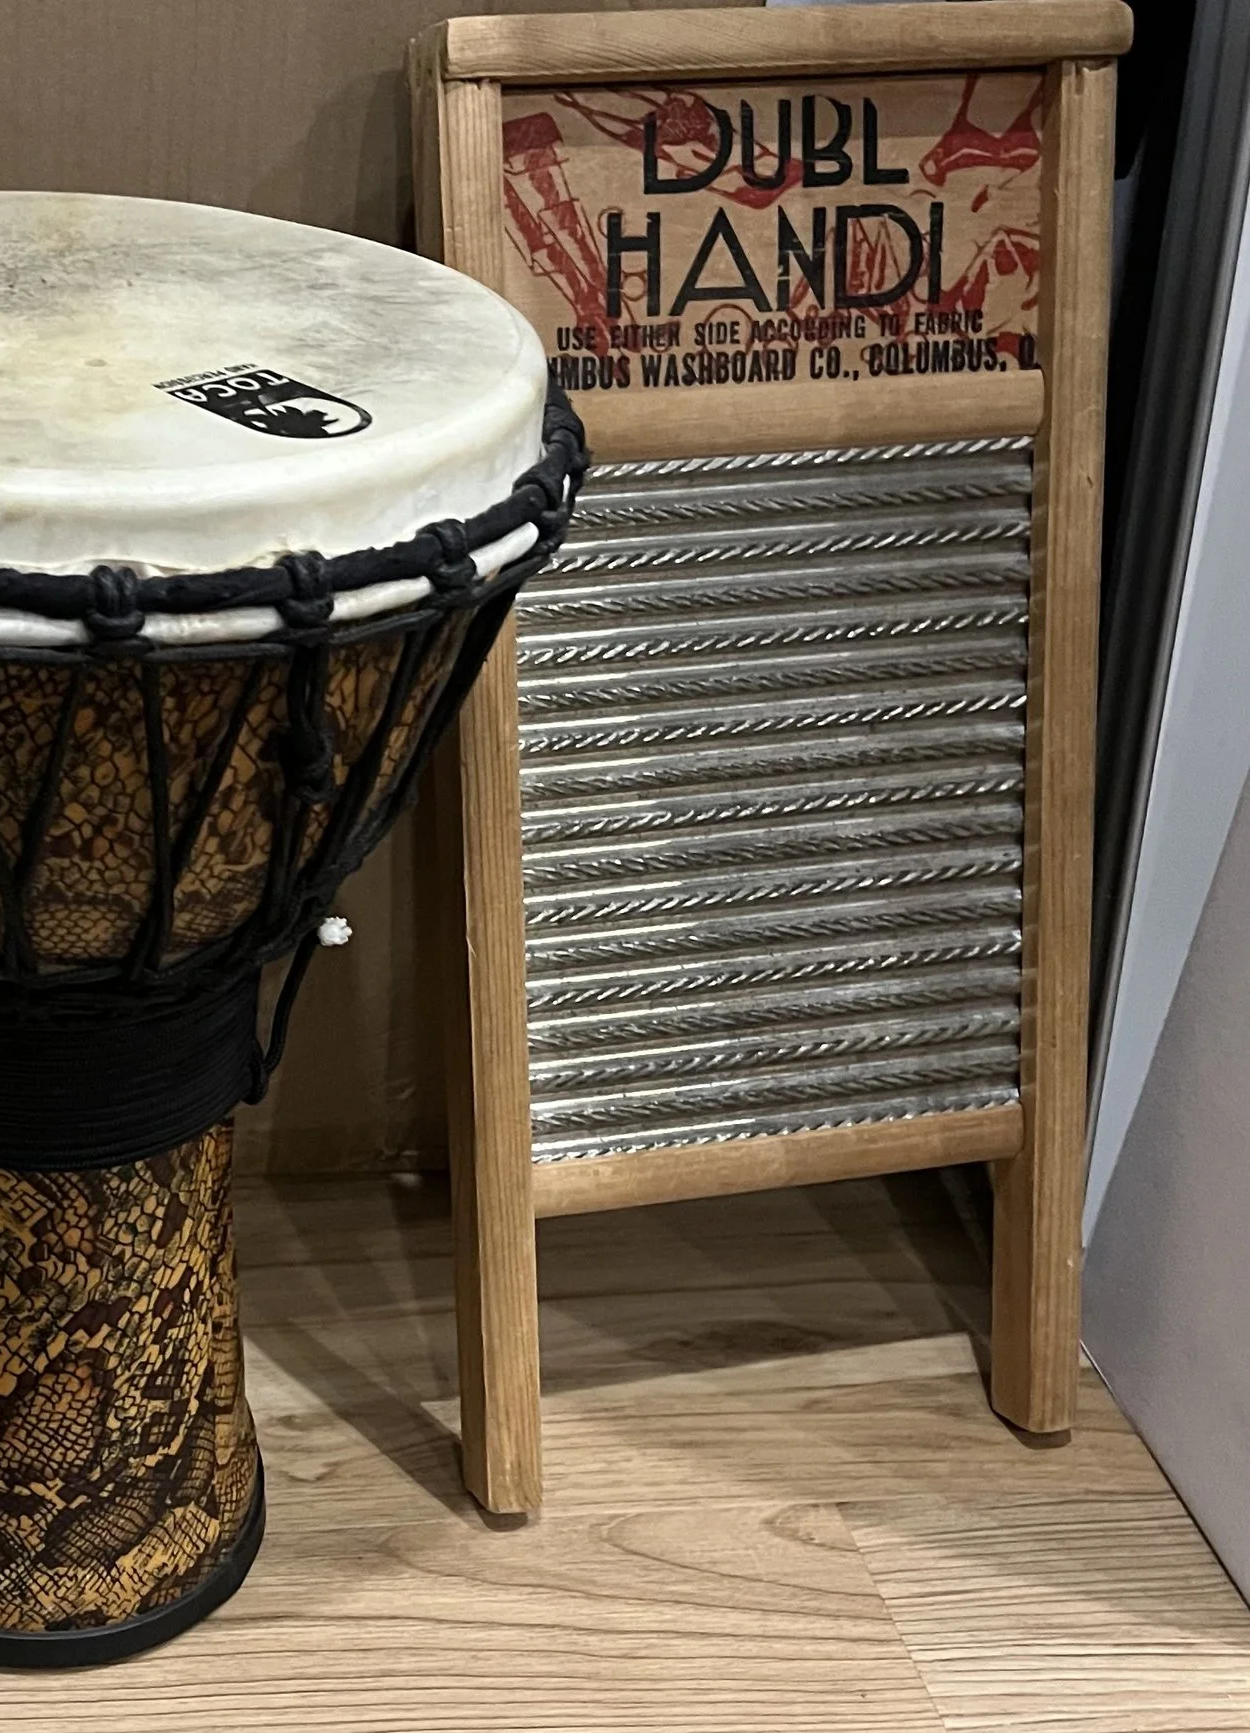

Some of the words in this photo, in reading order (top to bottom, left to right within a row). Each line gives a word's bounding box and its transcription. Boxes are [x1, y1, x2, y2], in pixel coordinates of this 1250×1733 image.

[643, 95, 909, 195] DUBL
[606, 201, 944, 318] HANDI
[556, 326, 598, 351] USE
[610, 319, 681, 349] EITHER
[693, 320, 741, 347] SIDE
[750, 313, 866, 343] ACCORDING
[879, 312, 900, 338] TO
[913, 309, 984, 336] FABRIC
[174, 372, 290, 403] TOCA
[640, 349, 797, 389] WASHBOARD
[809, 345, 860, 381] CO.,
[868, 336, 1007, 377] COLUMBUS,
